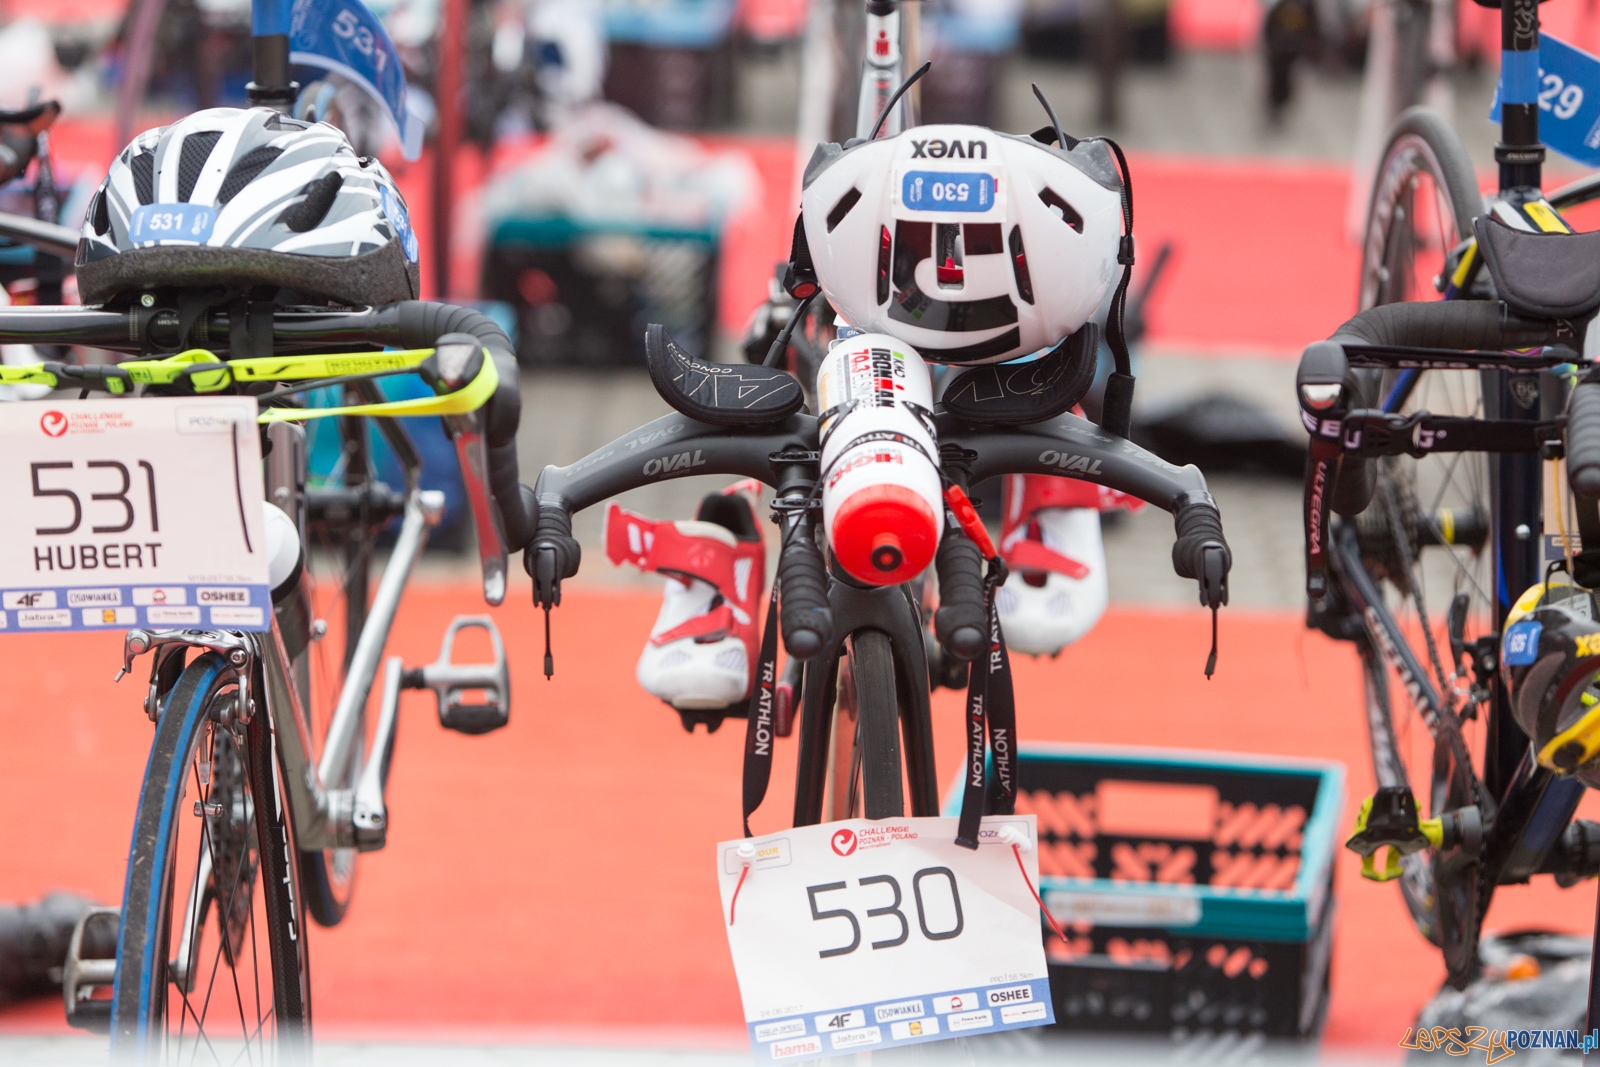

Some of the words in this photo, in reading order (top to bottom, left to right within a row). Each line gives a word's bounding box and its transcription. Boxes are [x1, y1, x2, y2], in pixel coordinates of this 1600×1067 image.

[331, 8, 387, 73] 531
[1538, 67, 1584, 120] 29
[911, 139, 987, 159] uvex
[932, 182, 970, 201] 530
[149, 213, 183, 230] 531
[624, 423, 685, 449] OVAL
[642, 450, 706, 476] OVAL
[1038, 449, 1102, 475] OVAL
[30, 459, 160, 535] 531
[1310, 461, 1327, 555] ULTEGRA
[33, 542, 162, 571] HUBERT
[16, 593, 42, 606] 4F
[201, 591, 245, 602] OSHEE
[755, 660, 774, 756] TRIATHLON
[971, 694, 984, 787] TRIATHLON
[994, 728, 1012, 792] ATHLON
[859, 826, 909, 837] CHALLENGE
[891, 832, 918, 841] POLAND
[806, 866, 964, 959] 530
[990, 988, 1030, 1003] OSHEE
[828, 1013, 851, 1028] 4F
[774, 1042, 816, 1057] hama
